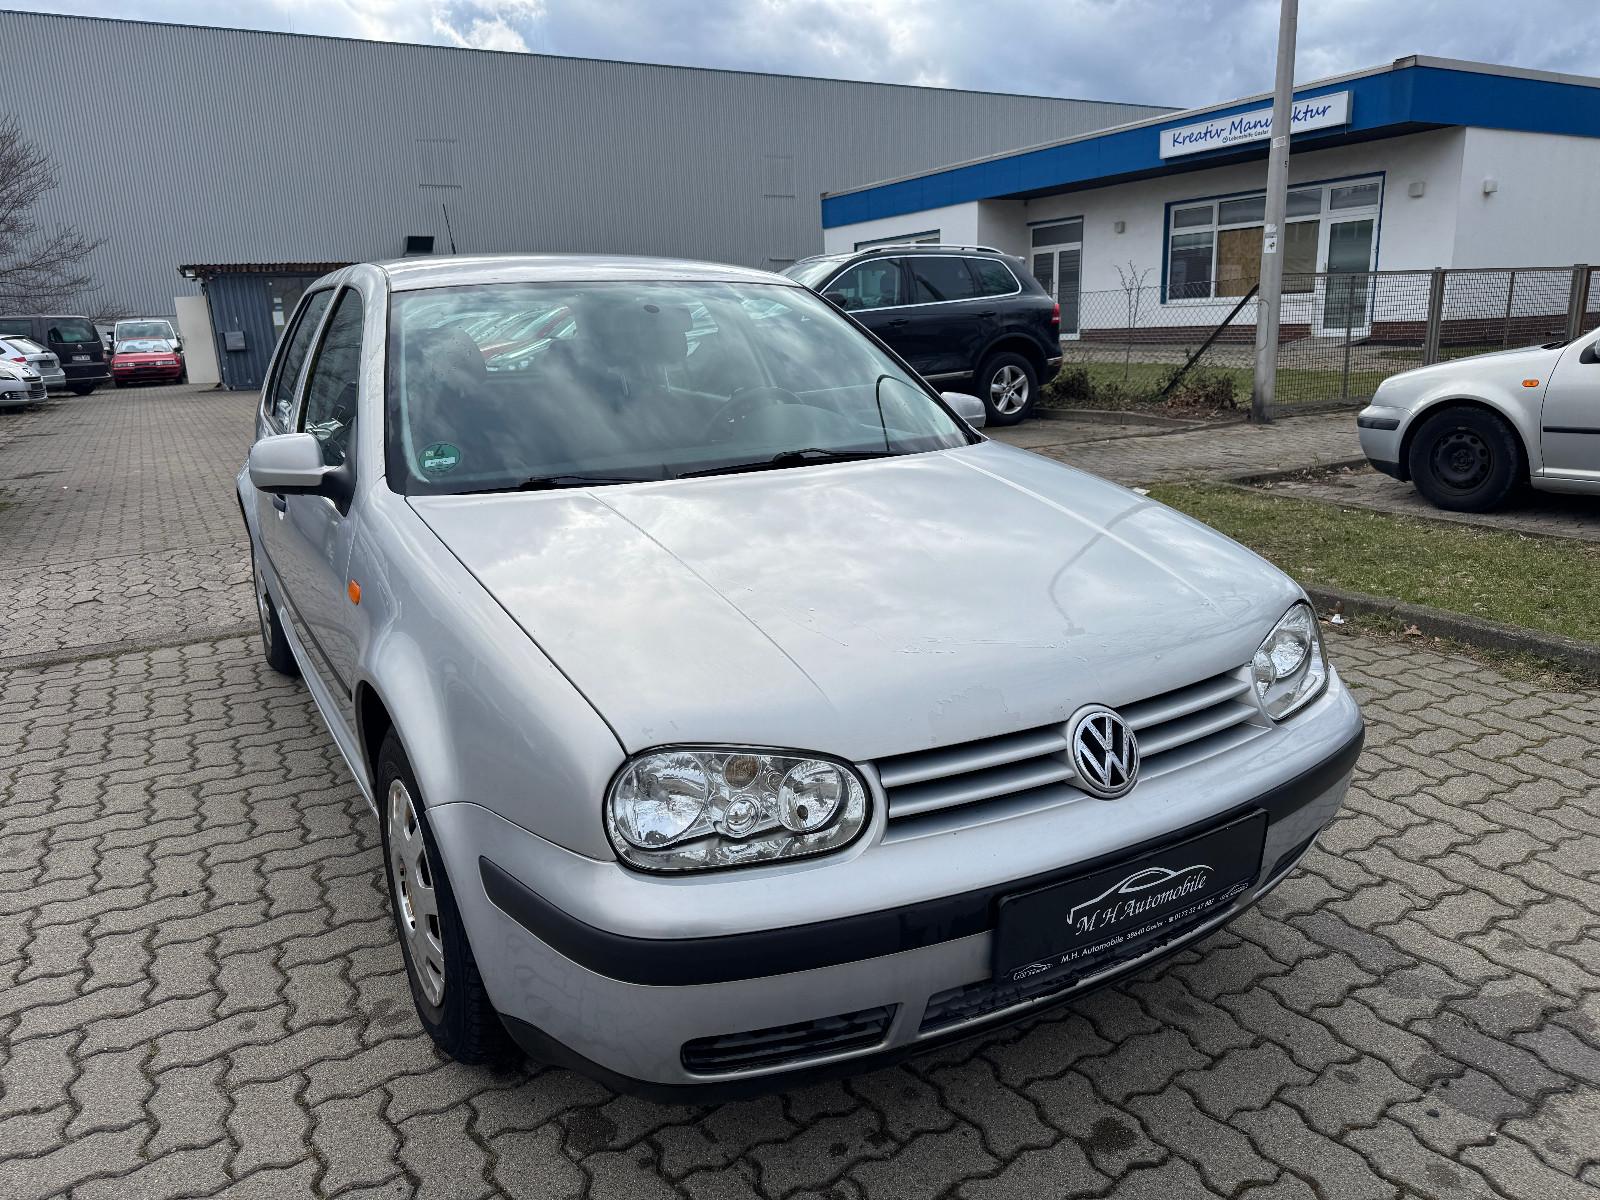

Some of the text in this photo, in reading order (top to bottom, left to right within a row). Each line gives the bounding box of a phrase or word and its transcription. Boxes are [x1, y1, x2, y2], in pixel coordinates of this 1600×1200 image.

[1172, 104, 1332, 148] Kreativ Manuktur
[434, 444, 445, 457] 4
[1075, 908, 1100, 936] M
[1100, 901, 1123, 927] H
[1120, 870, 1208, 920] Automobile
[1060, 951, 1080, 964] M.H.
[1081, 936, 1124, 957] Automobile
